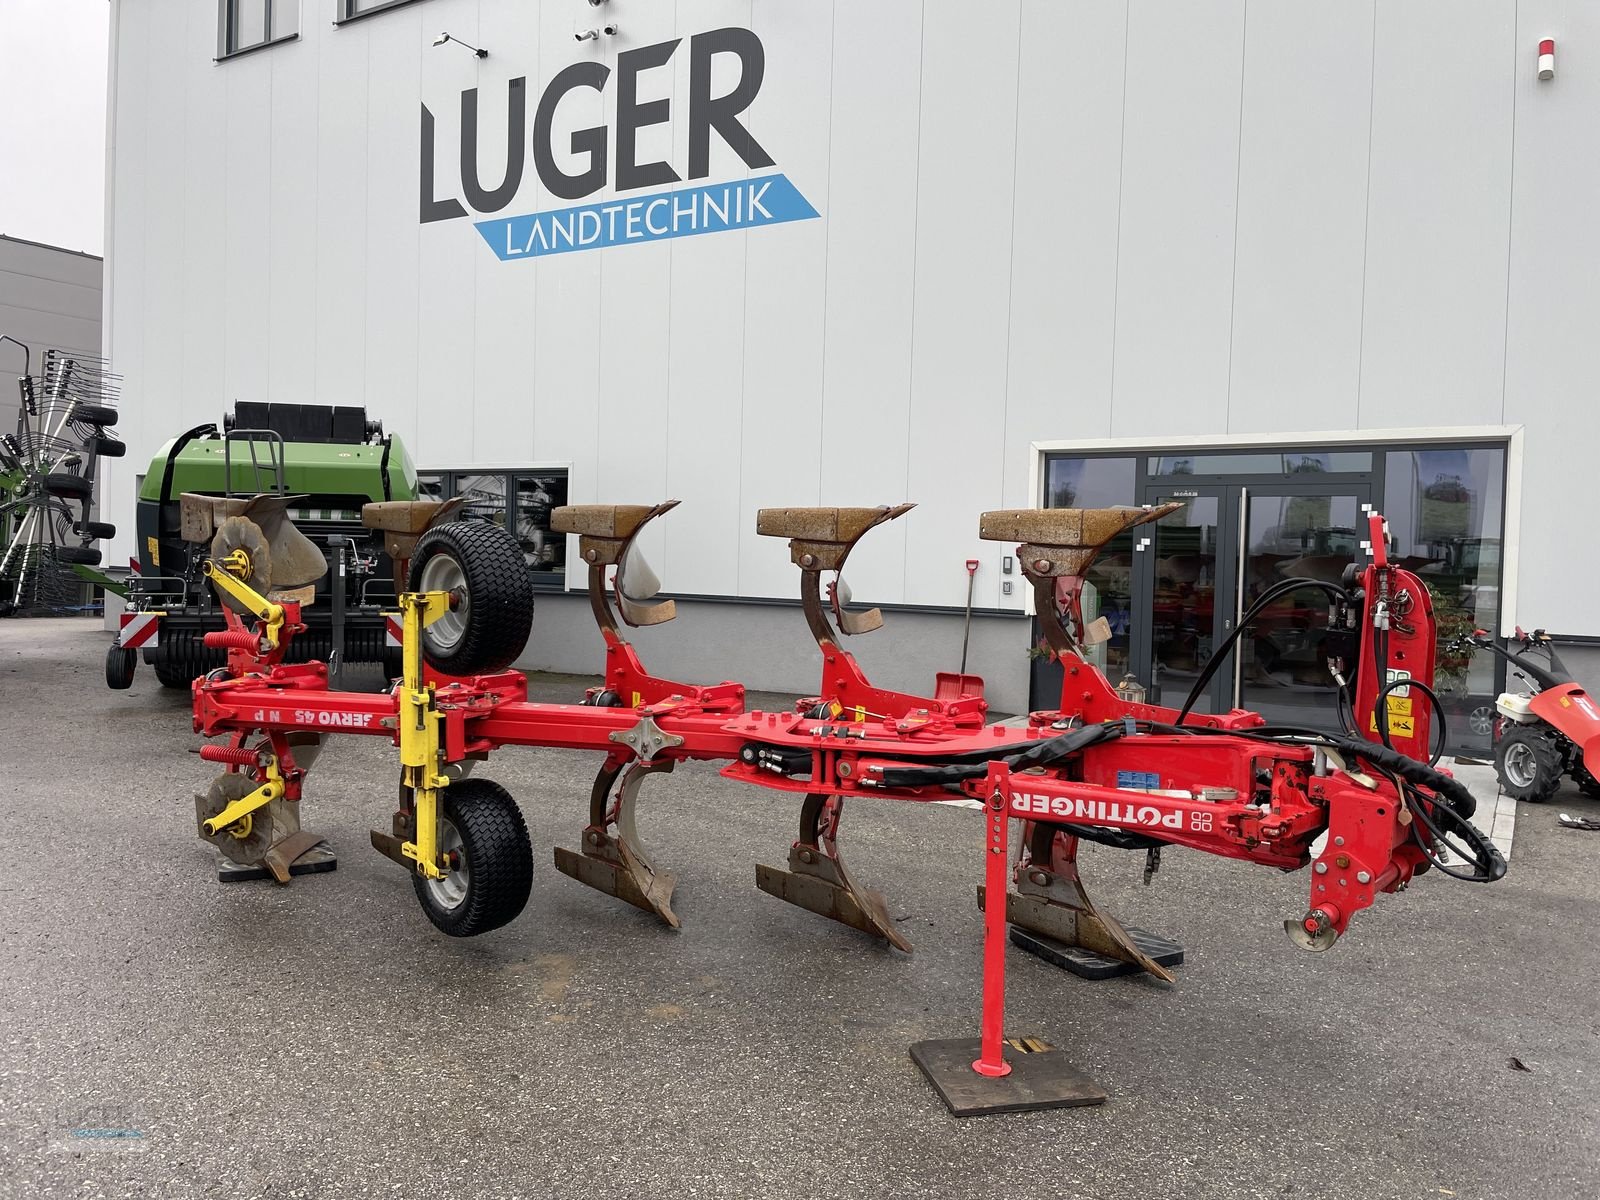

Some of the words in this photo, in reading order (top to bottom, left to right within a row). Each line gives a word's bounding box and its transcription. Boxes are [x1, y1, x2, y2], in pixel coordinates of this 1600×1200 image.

[420, 27, 777, 224] LUGER
[506, 181, 774, 257] LANDTECHNIK
[294, 710, 315, 724] 45
